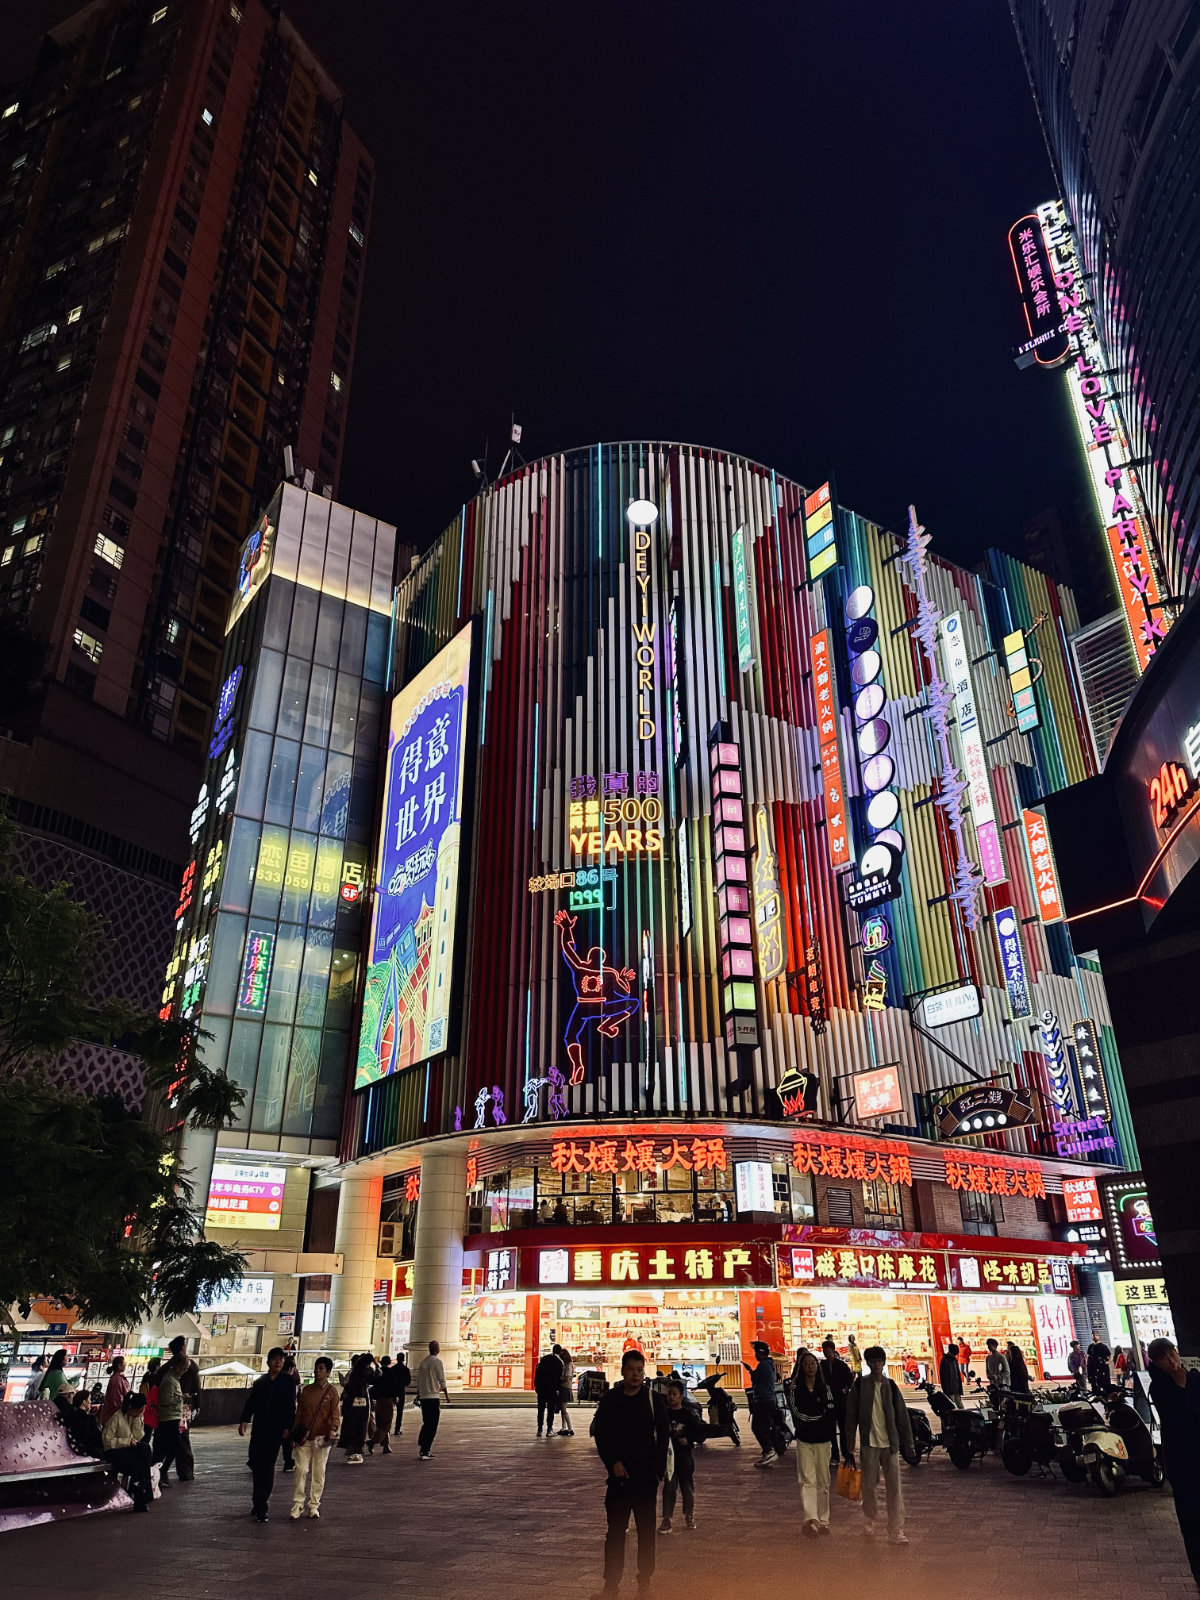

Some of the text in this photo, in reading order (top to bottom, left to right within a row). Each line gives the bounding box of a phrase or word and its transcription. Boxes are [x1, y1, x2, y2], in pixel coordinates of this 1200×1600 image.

[1018, 227, 1051, 319] 米乐汇娱乐会所
[1077, 356, 1112, 443] LOVE
[1105, 468, 1149, 593] PARTY
[633, 622, 656, 740] WORLD
[398, 712, 451, 795] 得意
[570, 771, 662, 800] 我真的
[1149, 761, 1189, 829] 24h
[394, 771, 447, 851] 世界
[603, 797, 663, 825] 500
[569, 829, 662, 856] YEARS
[342, 887, 358, 899] 5F
[569, 889, 604, 905] 1999
[850, 884, 892, 907] YUMMY!
[244, 936, 269, 1007] 机麻包房
[1052, 1116, 1106, 1138] Street
[1056, 1134, 1116, 1157] Cuisine
[573, 1248, 753, 1282] 重庆土特产
[815, 1251, 937, 1284] 磁器口陈麻花
[983, 1260, 1052, 1286] 怪味胡豆
